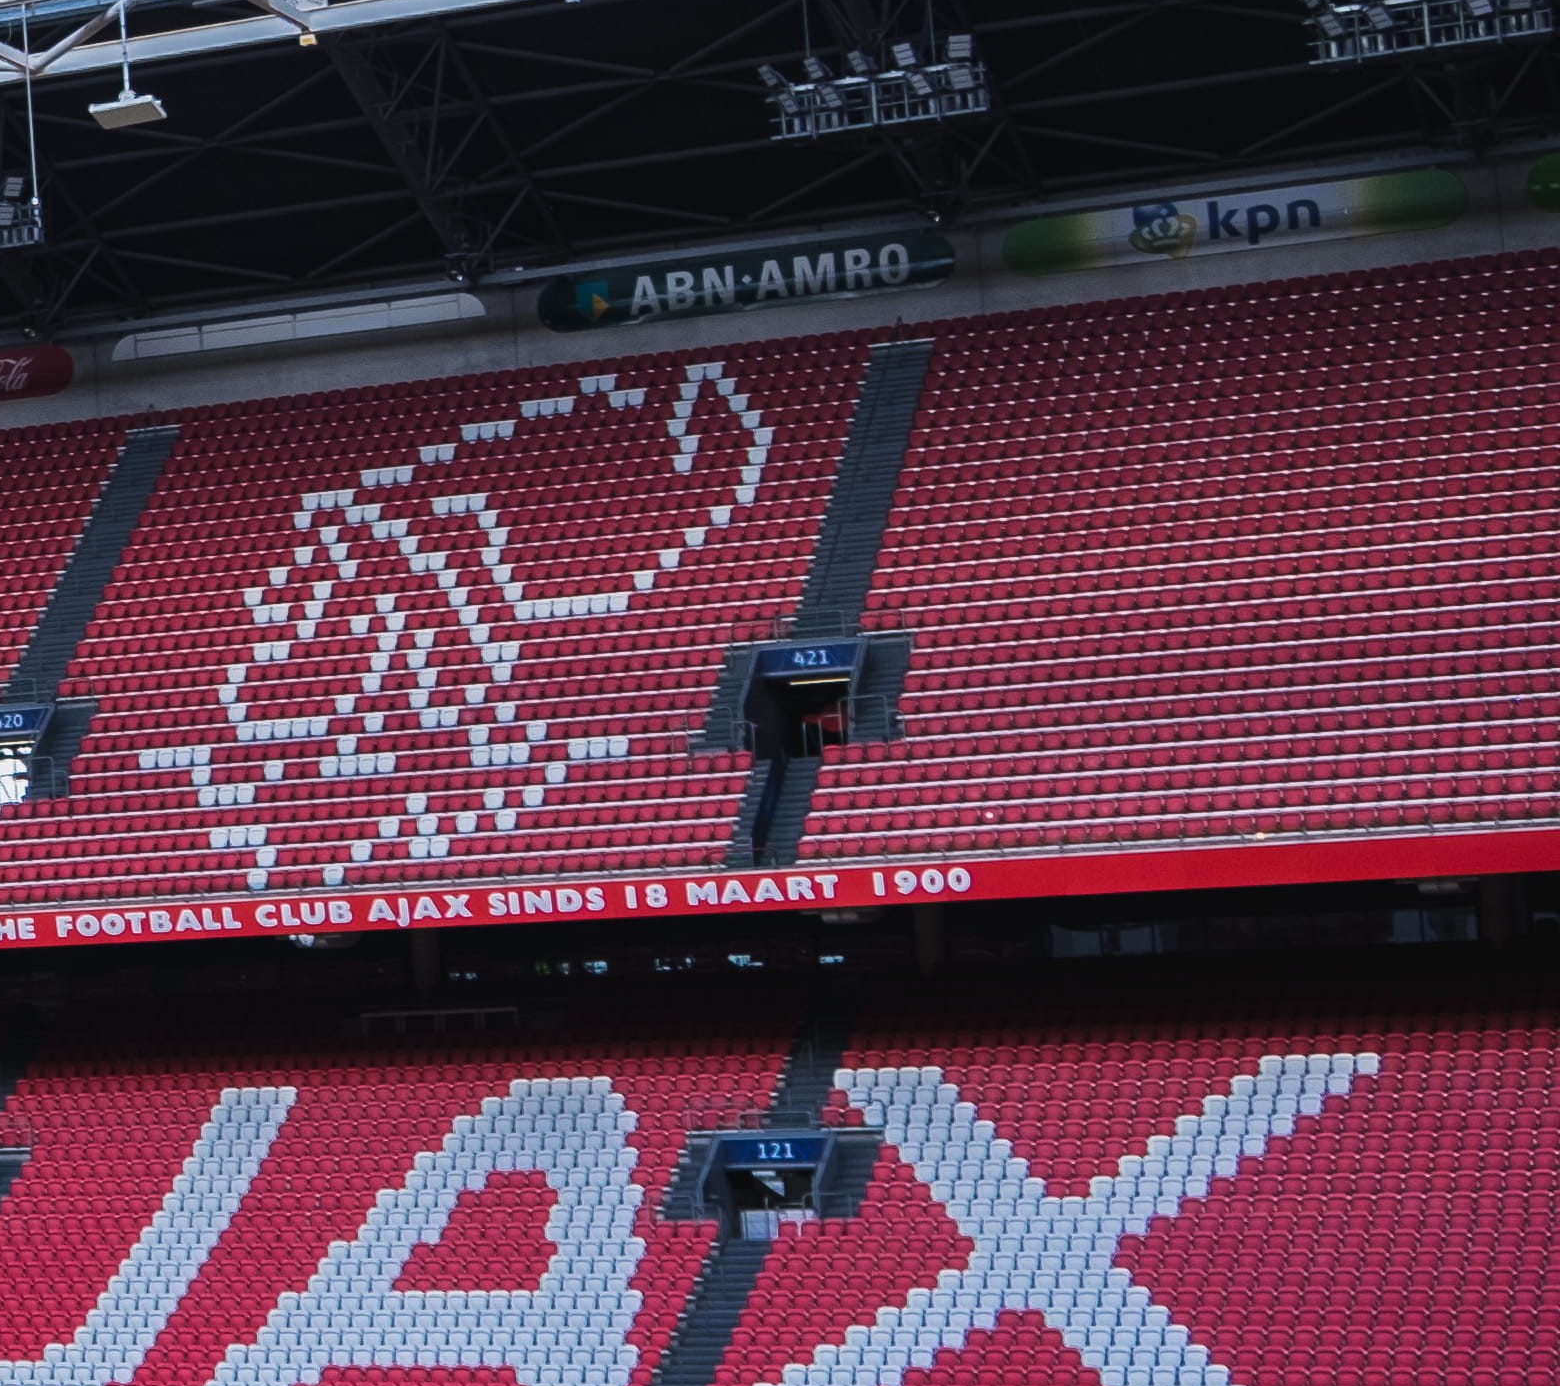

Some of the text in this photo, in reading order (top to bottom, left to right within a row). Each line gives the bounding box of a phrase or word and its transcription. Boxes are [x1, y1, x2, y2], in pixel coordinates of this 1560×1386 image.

[1207, 198, 1321, 246] kpn
[792, 650, 829, 667] 421
[55, 907, 242, 938] FOOTBALL
[254, 900, 353, 927] CLUB
[367, 894, 473, 927] AJAX
[488, 887, 606, 917] SINDS
[624, 884, 669, 909] 18
[685, 874, 839, 907] MAART
[872, 867, 971, 896] 1900
[758, 1143, 794, 1159] 121
